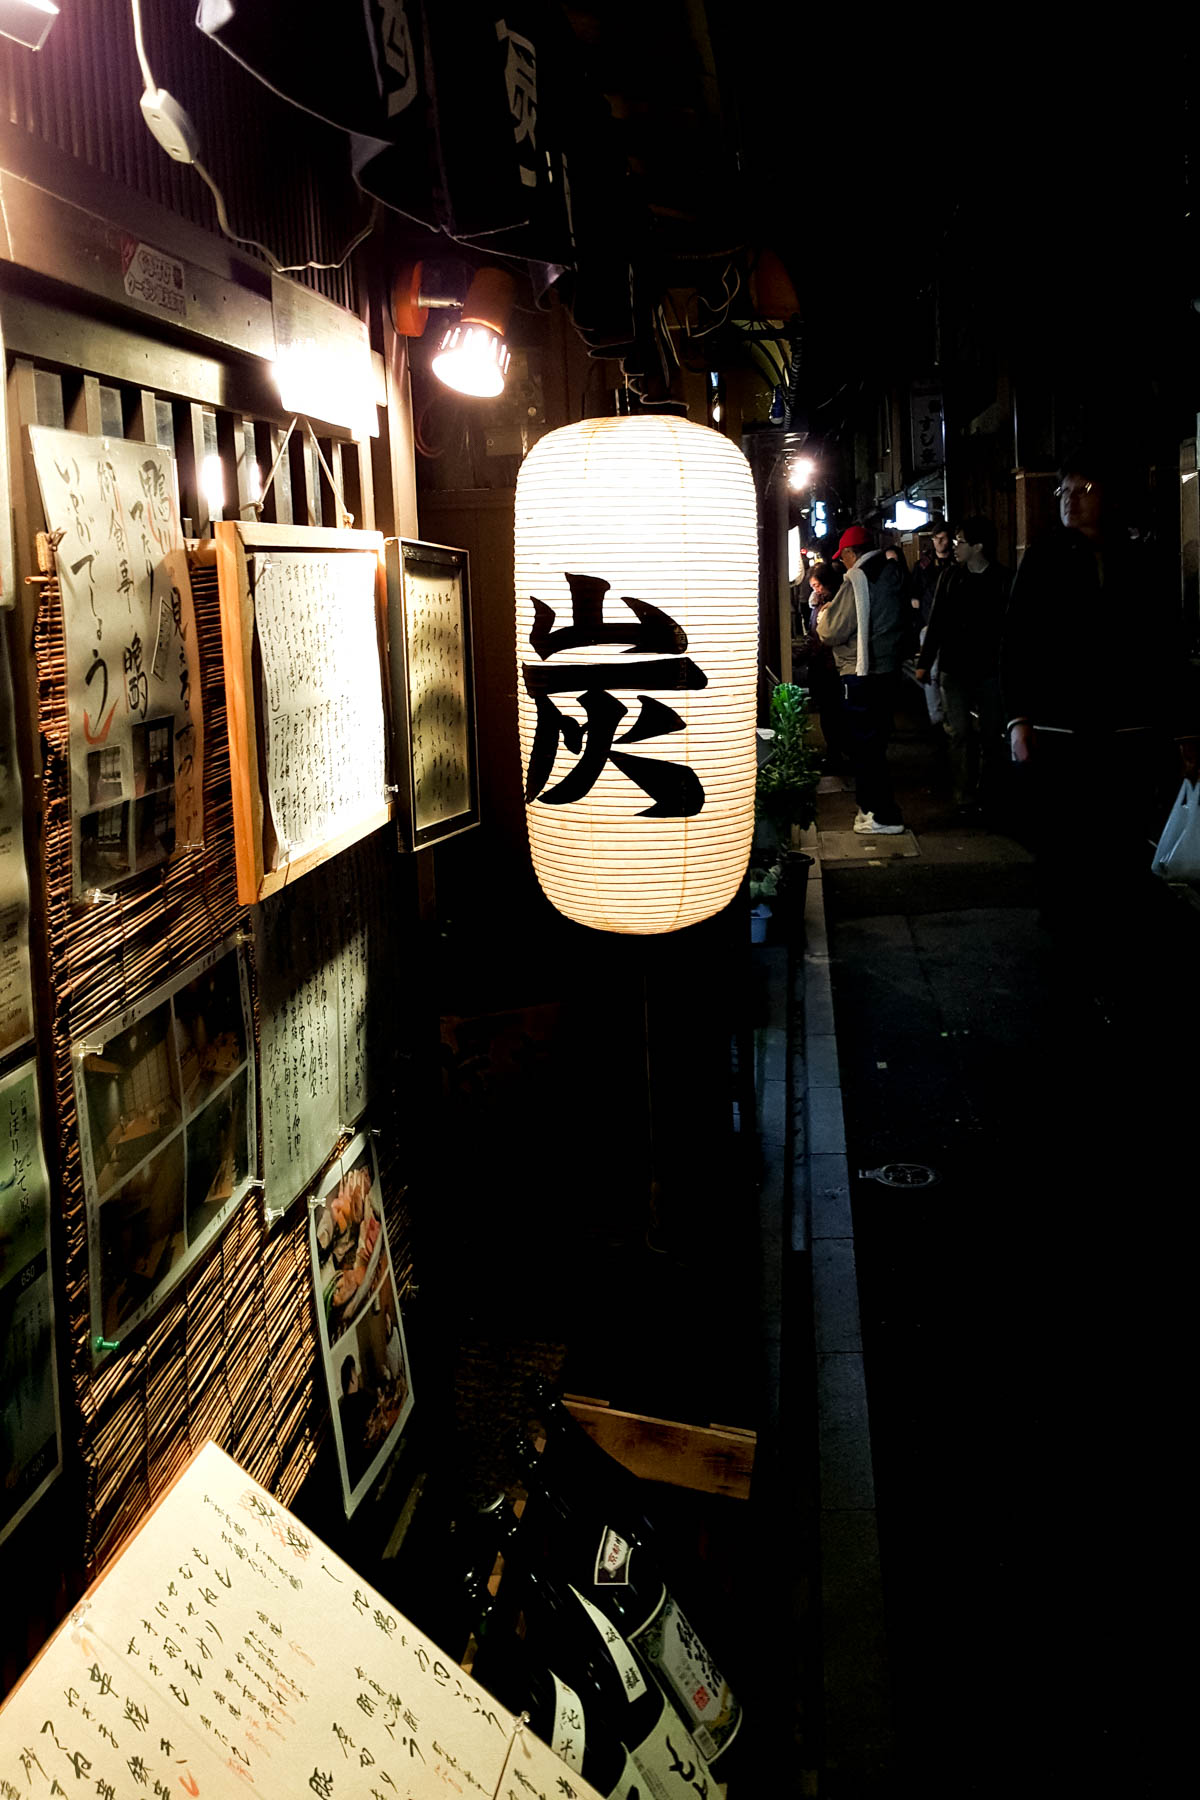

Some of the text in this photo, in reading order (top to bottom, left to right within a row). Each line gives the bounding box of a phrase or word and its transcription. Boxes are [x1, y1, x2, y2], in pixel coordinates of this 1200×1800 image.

[521, 571, 709, 818] 炭
[178, 1563, 219, 1608] むね
[191, 1547, 232, 1589] もも
[154, 1601, 213, 1660] はらみ
[167, 1581, 223, 1643] せせり
[126, 1636, 190, 1707] せぎも
[140, 1619, 203, 1686] 手羽元
[63, 1687, 120, 1749] ねぎま
[87, 1662, 188, 1765] 串焼き
[355, 1692, 426, 1765] 豚バラ
[559, 1708, 582, 1763] 純米
